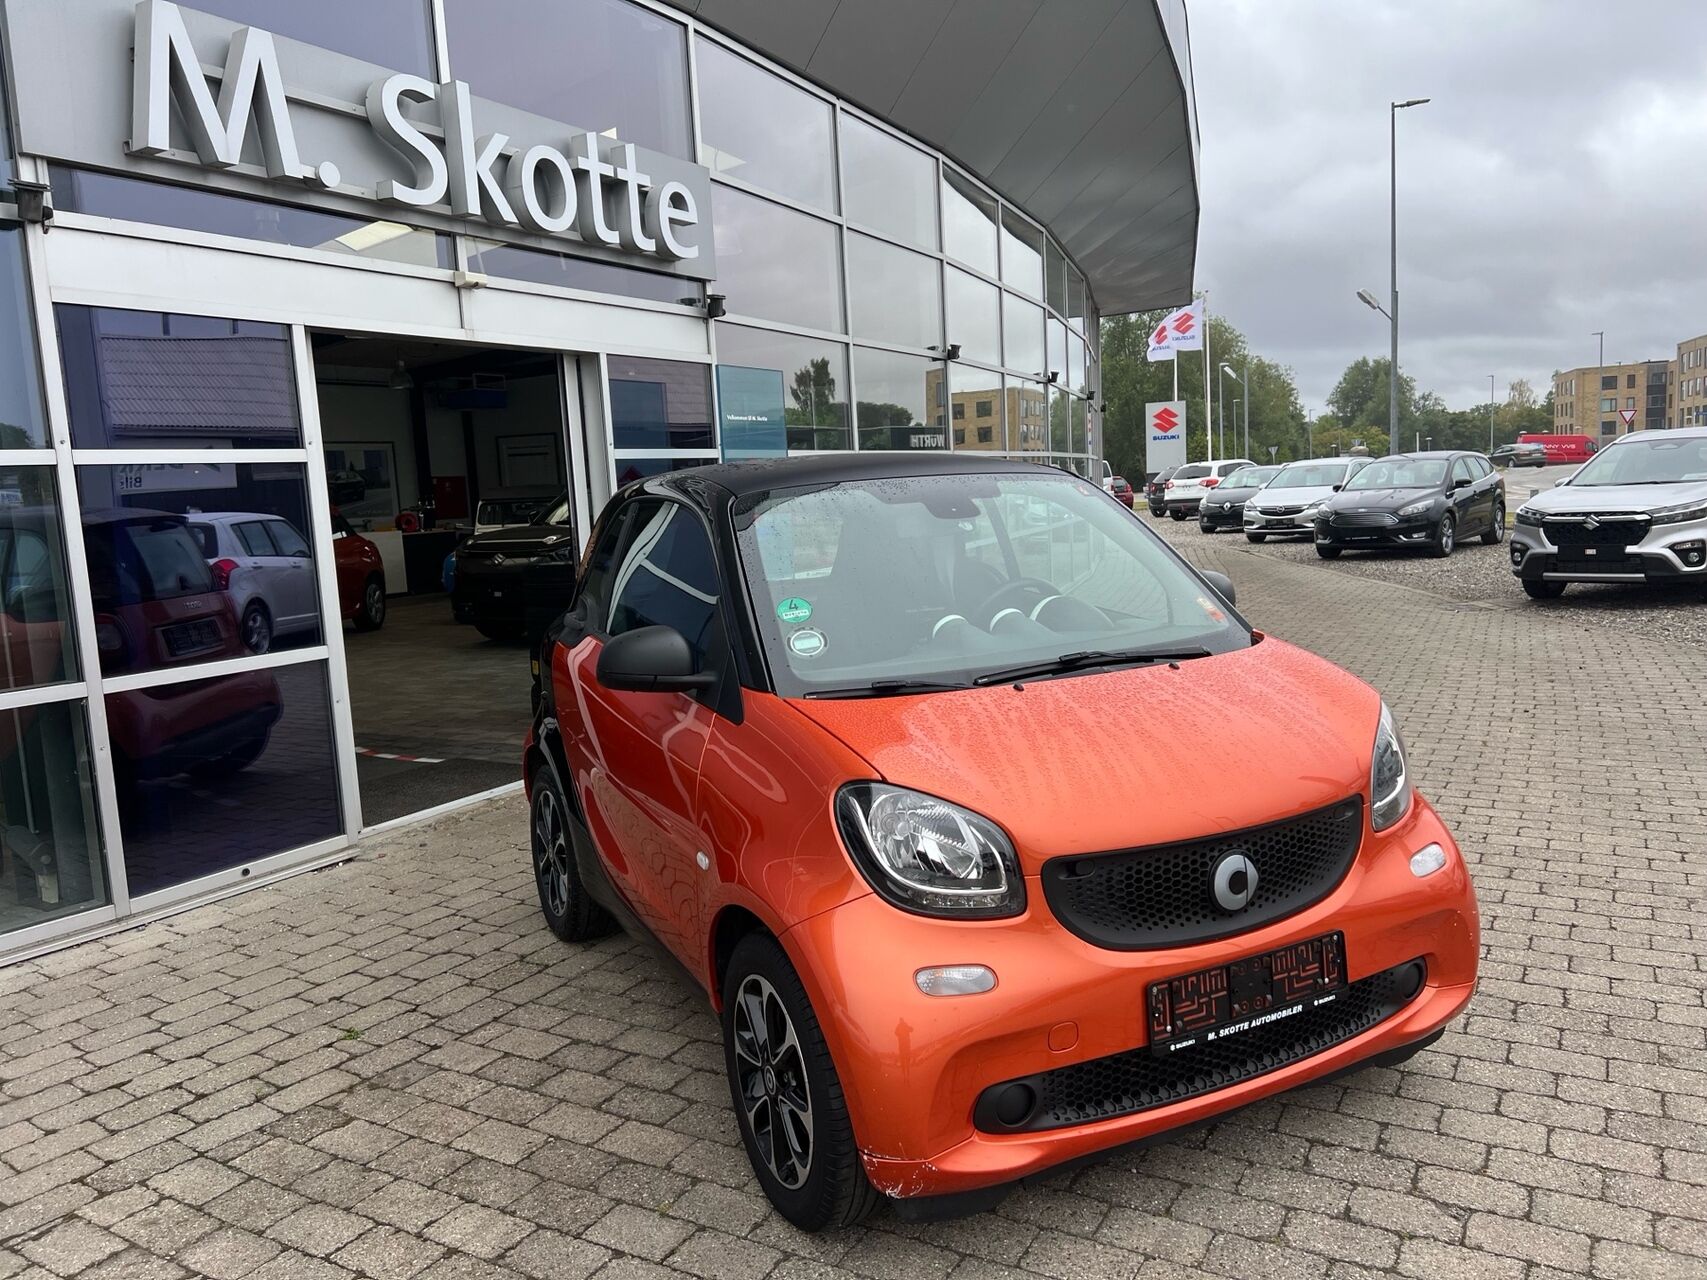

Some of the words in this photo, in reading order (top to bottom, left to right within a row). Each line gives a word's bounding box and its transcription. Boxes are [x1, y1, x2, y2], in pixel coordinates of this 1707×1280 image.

[131, 0, 341, 188] M.
[366, 73, 699, 261] Skotte
[789, 599, 799, 610] 4
[1318, 995, 1336, 1004] SUZUKI
[1207, 1031, 1218, 1041] M.
[1218, 1021, 1250, 1037] SKOTTE
[1250, 1004, 1303, 1027] AUTOMOBILER
[1175, 1039, 1195, 1049] SUZUKI
